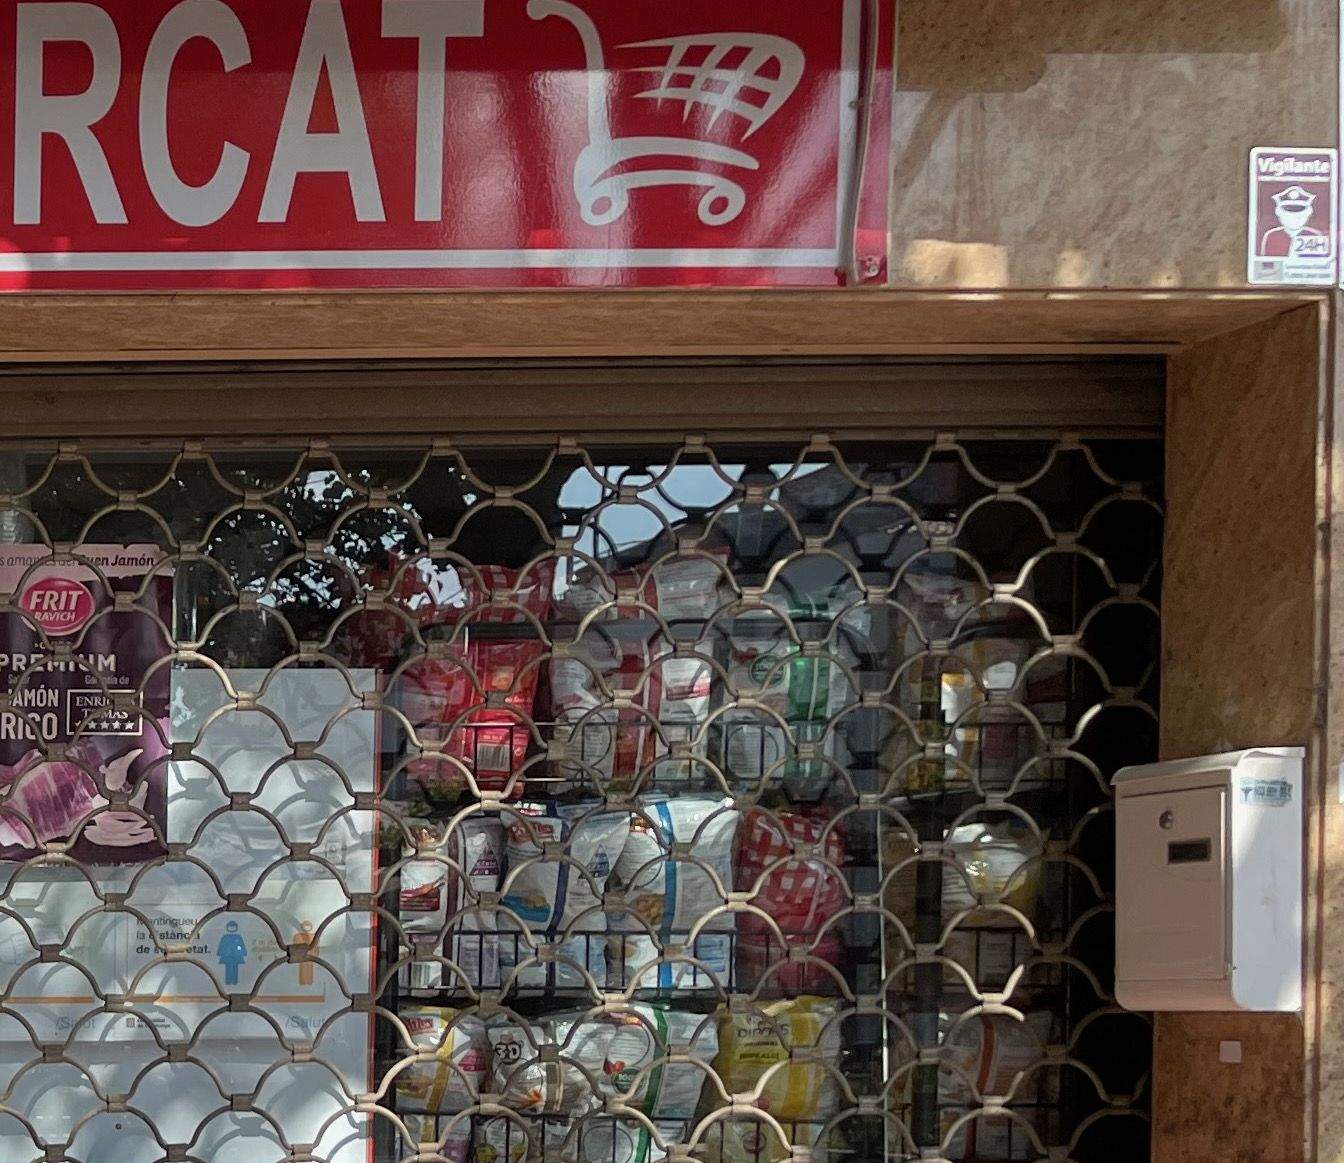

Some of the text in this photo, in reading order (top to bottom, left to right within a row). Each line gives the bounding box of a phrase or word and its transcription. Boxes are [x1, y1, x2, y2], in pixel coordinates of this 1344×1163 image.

[1258, 157, 1330, 176] Vigilante
[111, 552, 154, 568] Jamón
[29, 590, 84, 611] FRIT
[136, 945, 150, 955] de
